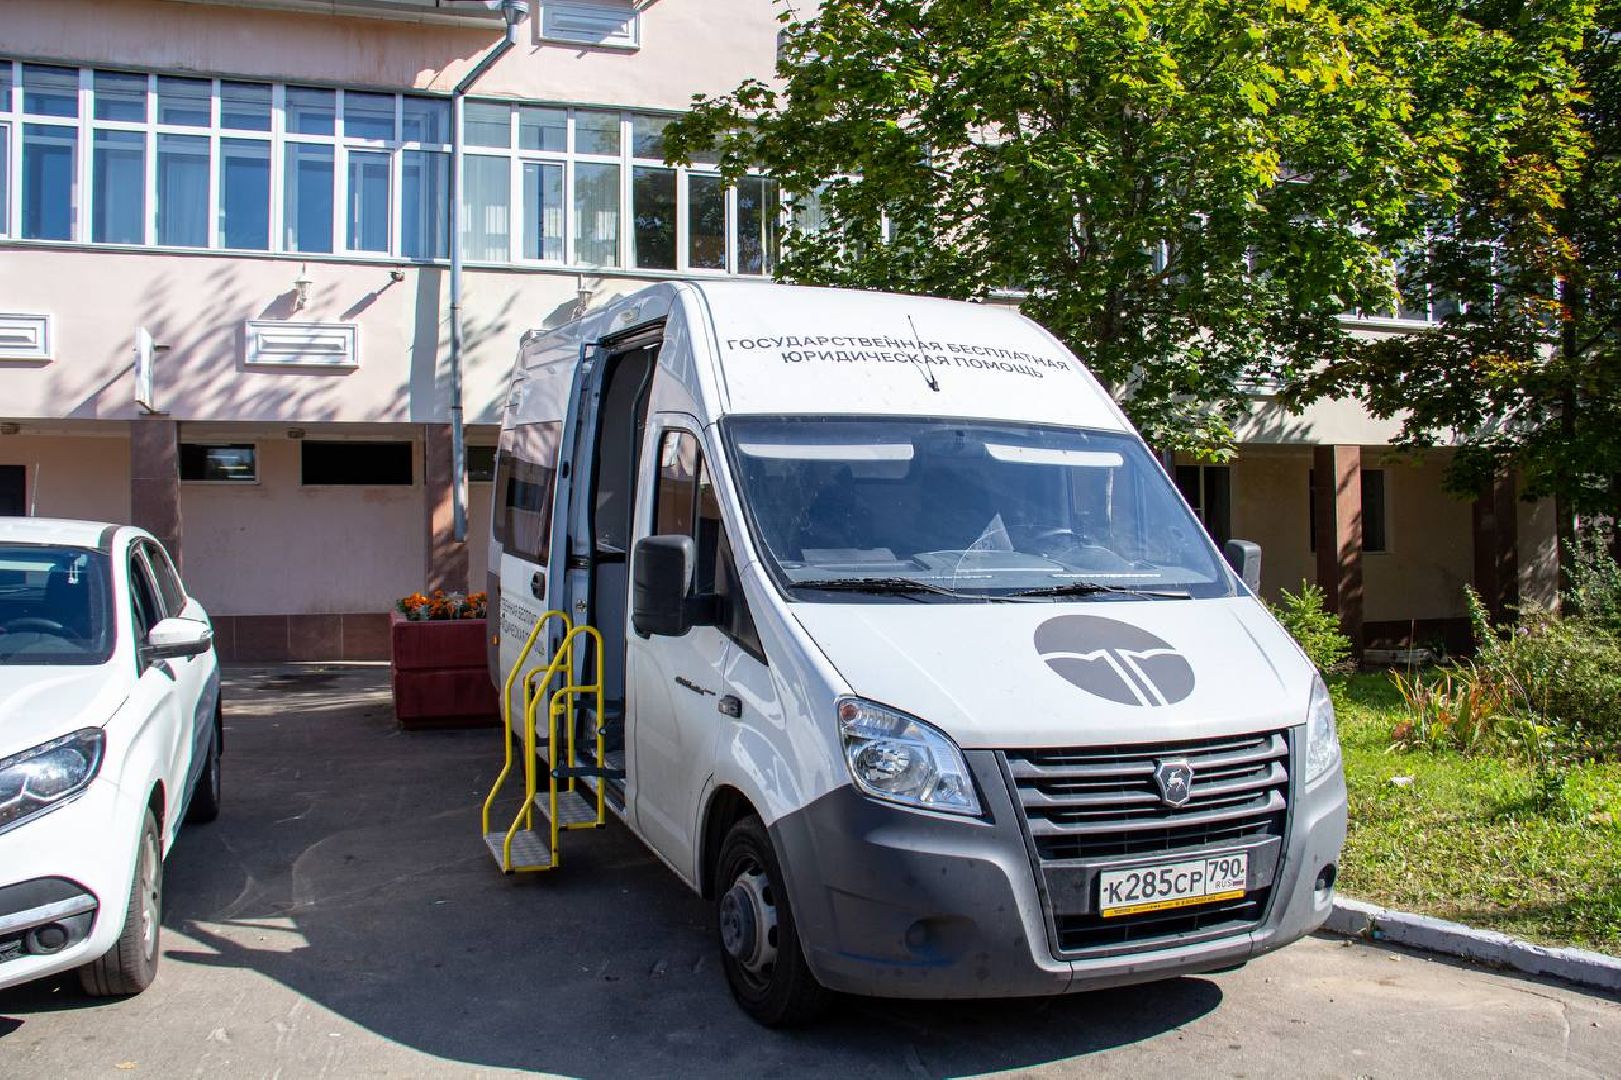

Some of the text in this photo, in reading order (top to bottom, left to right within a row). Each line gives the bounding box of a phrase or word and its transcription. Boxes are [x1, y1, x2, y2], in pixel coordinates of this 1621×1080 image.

[727, 335, 1071, 371] ГОСУДАРСТВЕННАЯ БЕСПЛАТНАЯ
[781, 350, 1044, 378] ЮРИДИЧЕСКАЯ ПОМОЩЬ
[1208, 858, 1242, 883] 790
